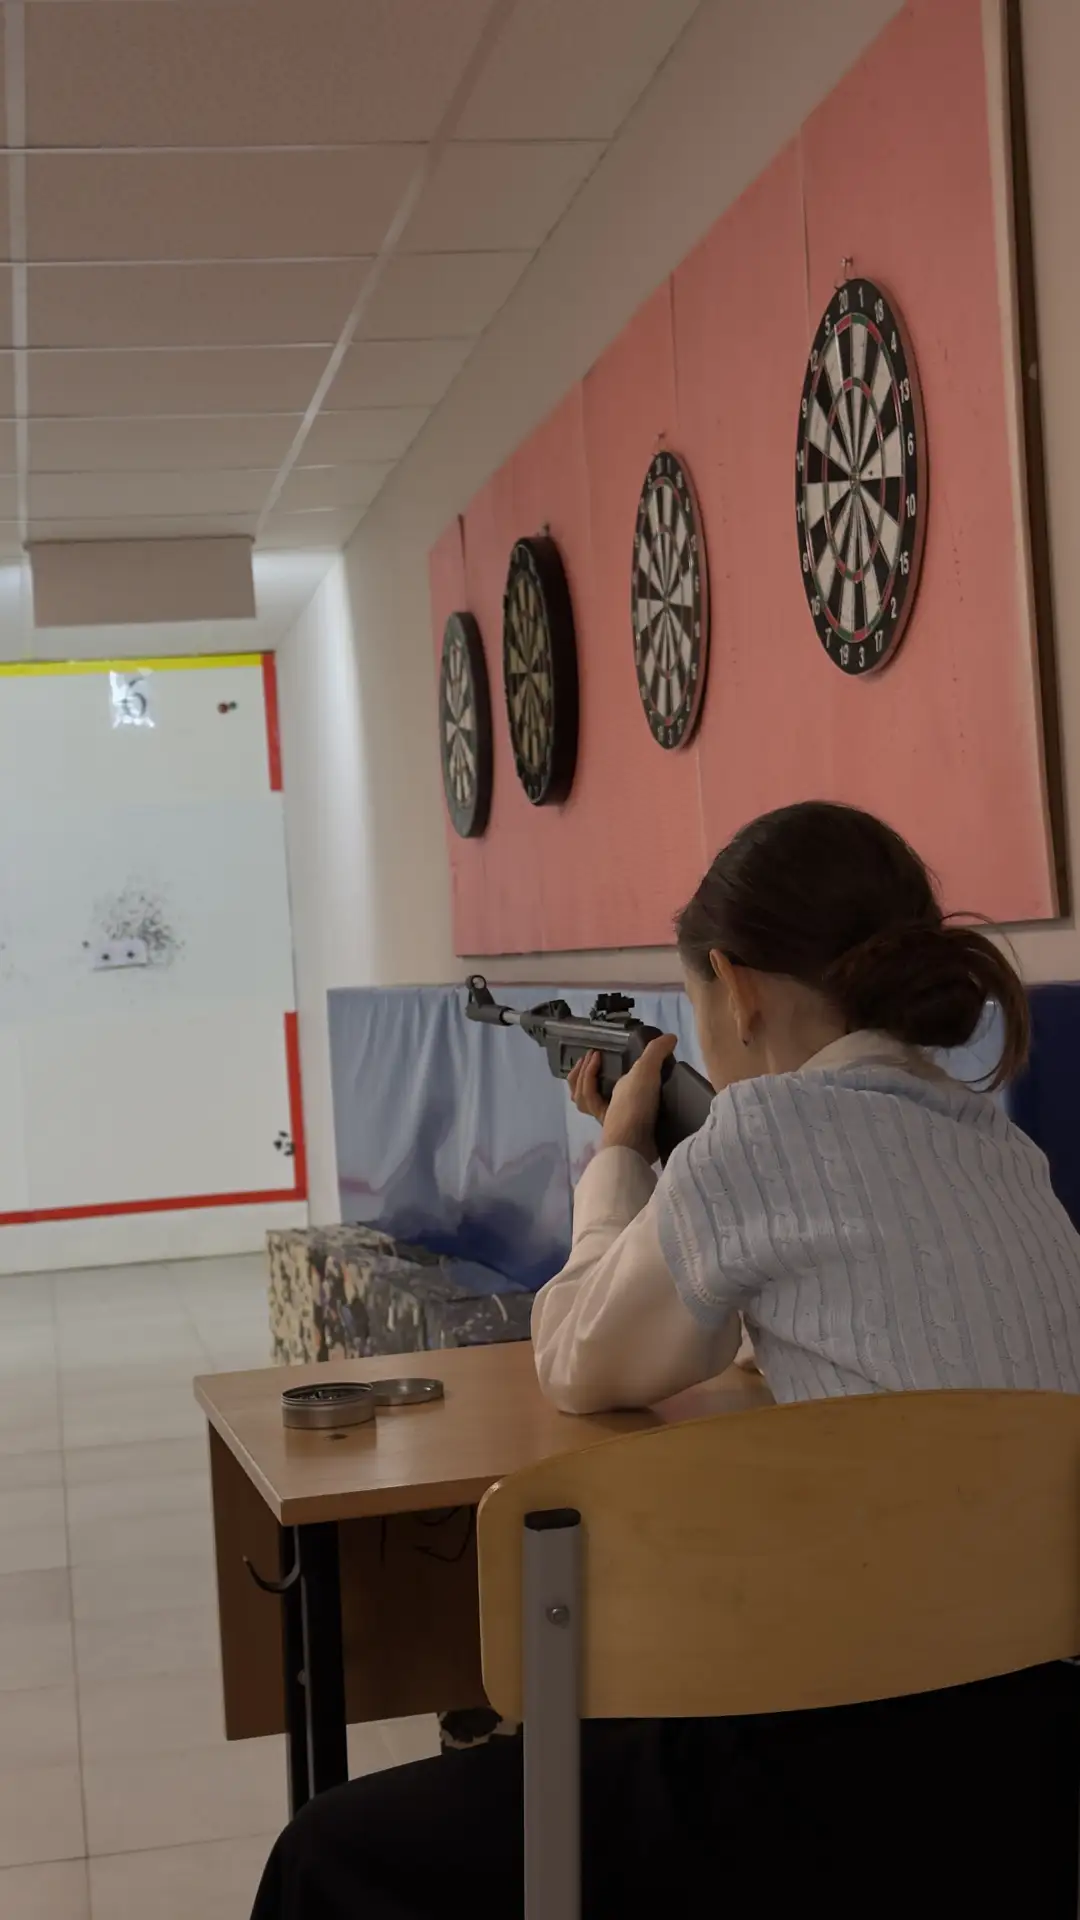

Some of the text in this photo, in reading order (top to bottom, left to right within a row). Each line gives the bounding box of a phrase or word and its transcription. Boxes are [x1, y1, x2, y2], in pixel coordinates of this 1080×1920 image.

[838, 290, 849, 314] 20
[858, 286, 864, 308] 1
[874, 298, 884, 323] 18
[824, 314, 832, 336] 5
[890, 331, 897, 353] 4
[899, 378, 910, 403] 13
[802, 399, 808, 418] 9
[907, 432, 914, 456] 6
[906, 493, 916, 518] 10
[802, 552, 809, 573] 8
[900, 551, 909, 576] 15
[890, 597, 897, 618] 2
[825, 628, 832, 648] 7
[874, 630, 884, 652] 17
[858, 647, 865, 667] 3
